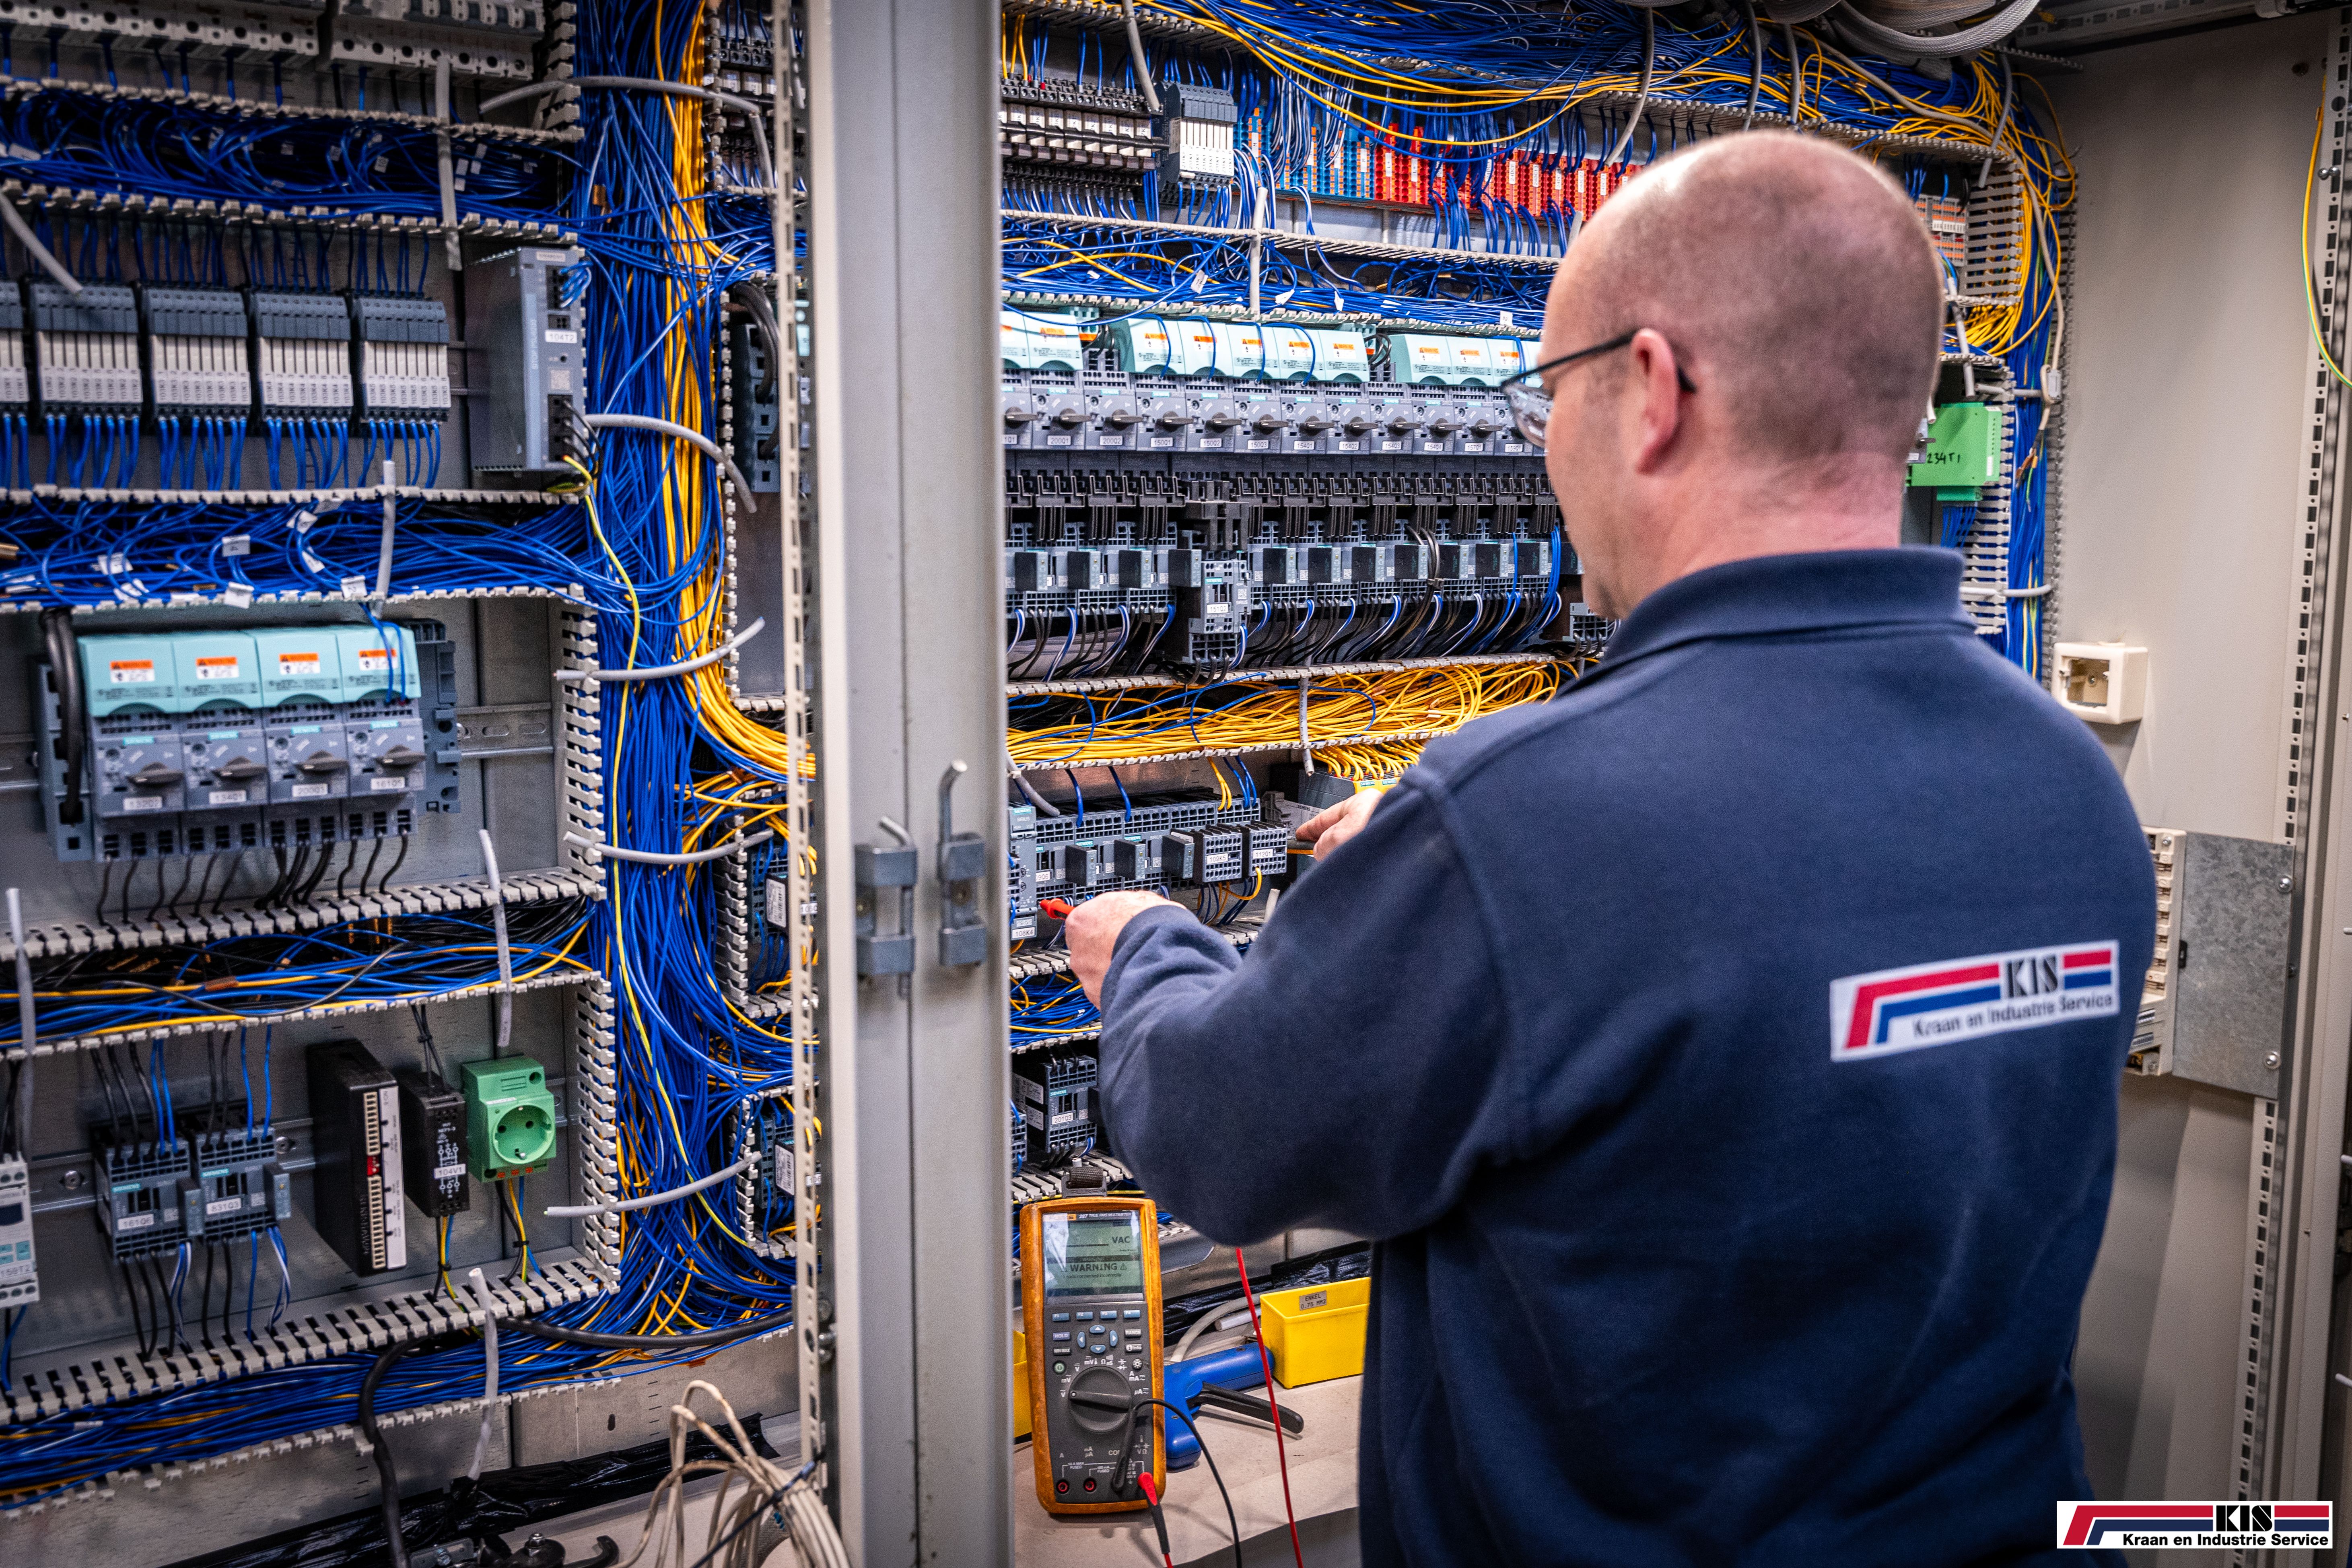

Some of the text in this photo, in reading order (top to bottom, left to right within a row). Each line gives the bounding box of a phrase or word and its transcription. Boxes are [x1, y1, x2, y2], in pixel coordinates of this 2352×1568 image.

[2005, 954, 2058, 998] KIS
[1914, 994, 2112, 1038] Kraan en Industrie Service
[1055, 1115, 1072, 1123] 201Q3
[439, 1167, 462, 1176] 104V1
[1070, 1263, 1117, 1272] WARNING
